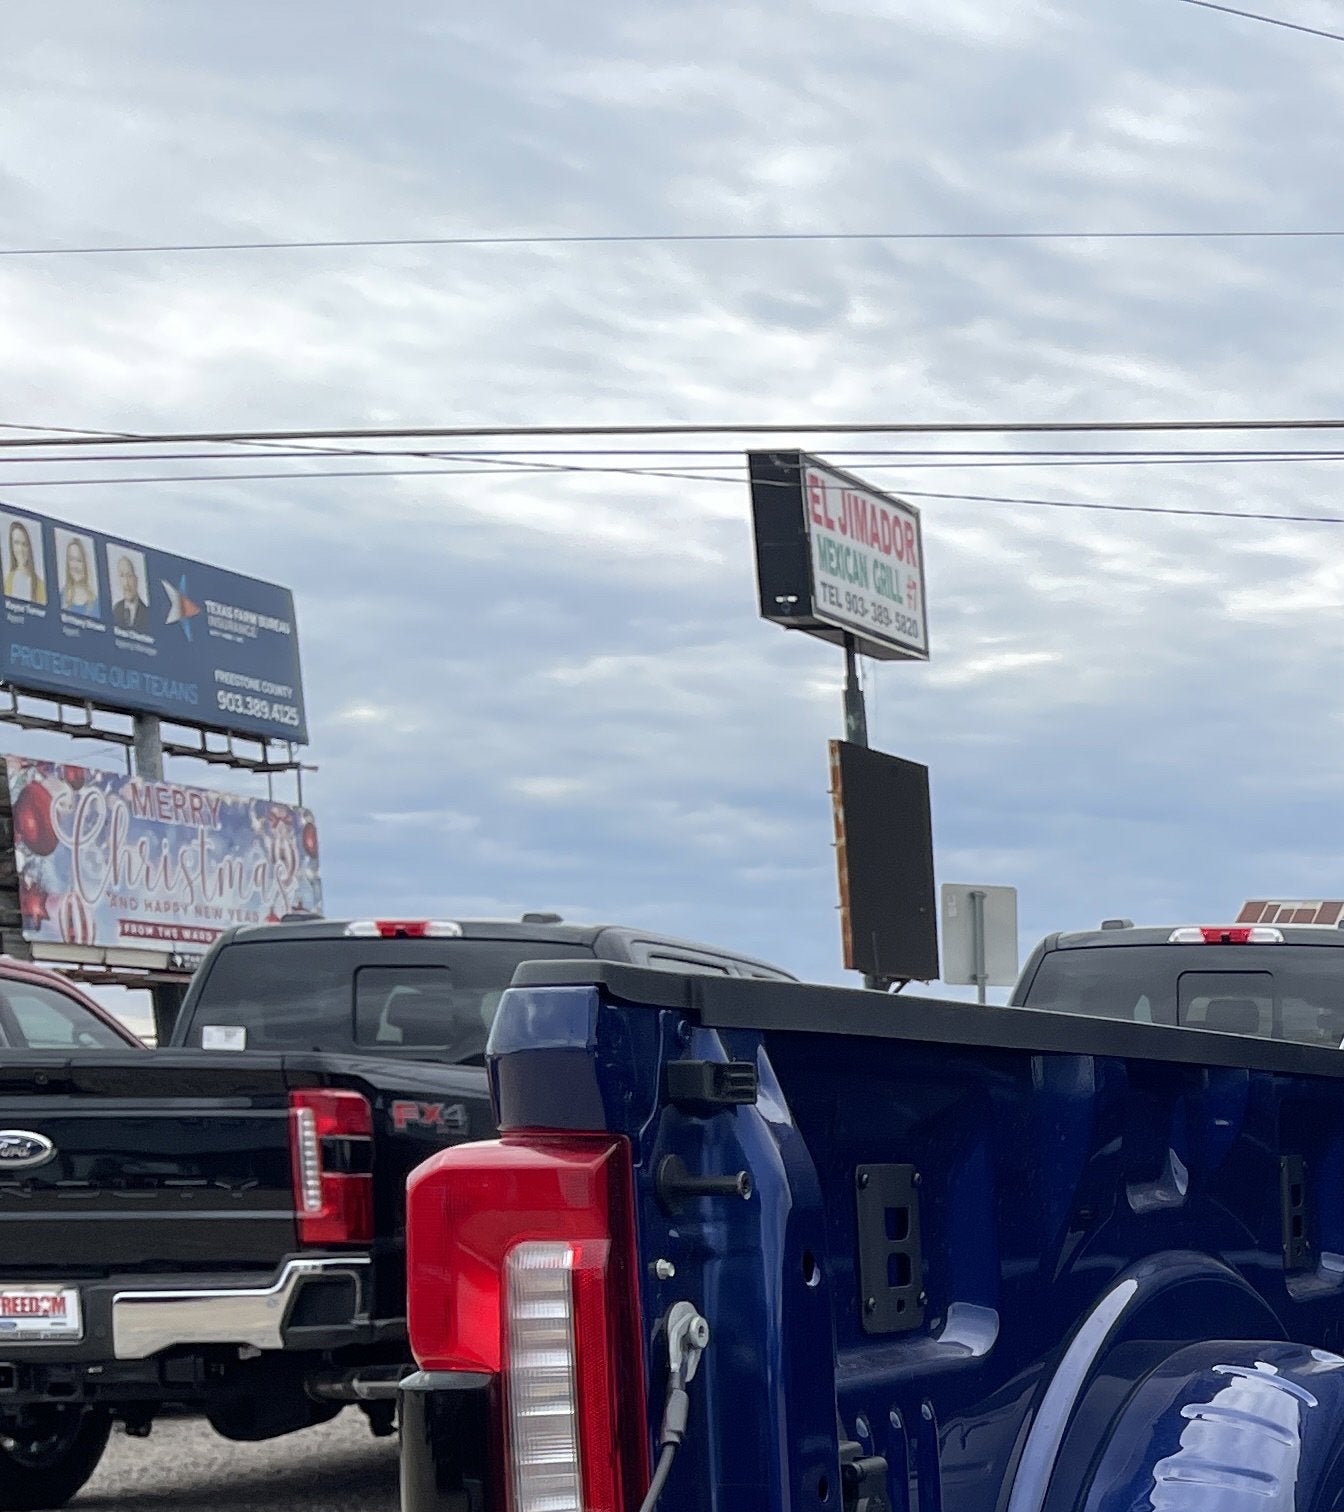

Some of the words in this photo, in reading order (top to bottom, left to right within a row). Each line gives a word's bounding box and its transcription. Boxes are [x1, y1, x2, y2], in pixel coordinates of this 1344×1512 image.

[808, 473, 834, 531] EL
[839, 488, 917, 567] JIMADOR
[817, 534, 869, 591] MEXICAN
[873, 559, 903, 604] GRILL
[820, 581, 843, 609] TEL
[205, 600, 233, 619] TEXAS
[10, 643, 107, 685] PROTECTING
[110, 665, 138, 690] OUR
[142, 672, 198, 705] TEXANS
[131, 782, 222, 830] MERRY
[51, 786, 299, 915] Christmas
[110, 898, 138, 911] AND
[144, 899, 189, 914] HAPPY
[194, 906, 223, 920] NEW
[124, 923, 153, 936] FROM
[158, 926, 178, 938] THE
[392, 1101, 466, 1128] FX4
[0, 1296, 66, 1315] REEDOM
